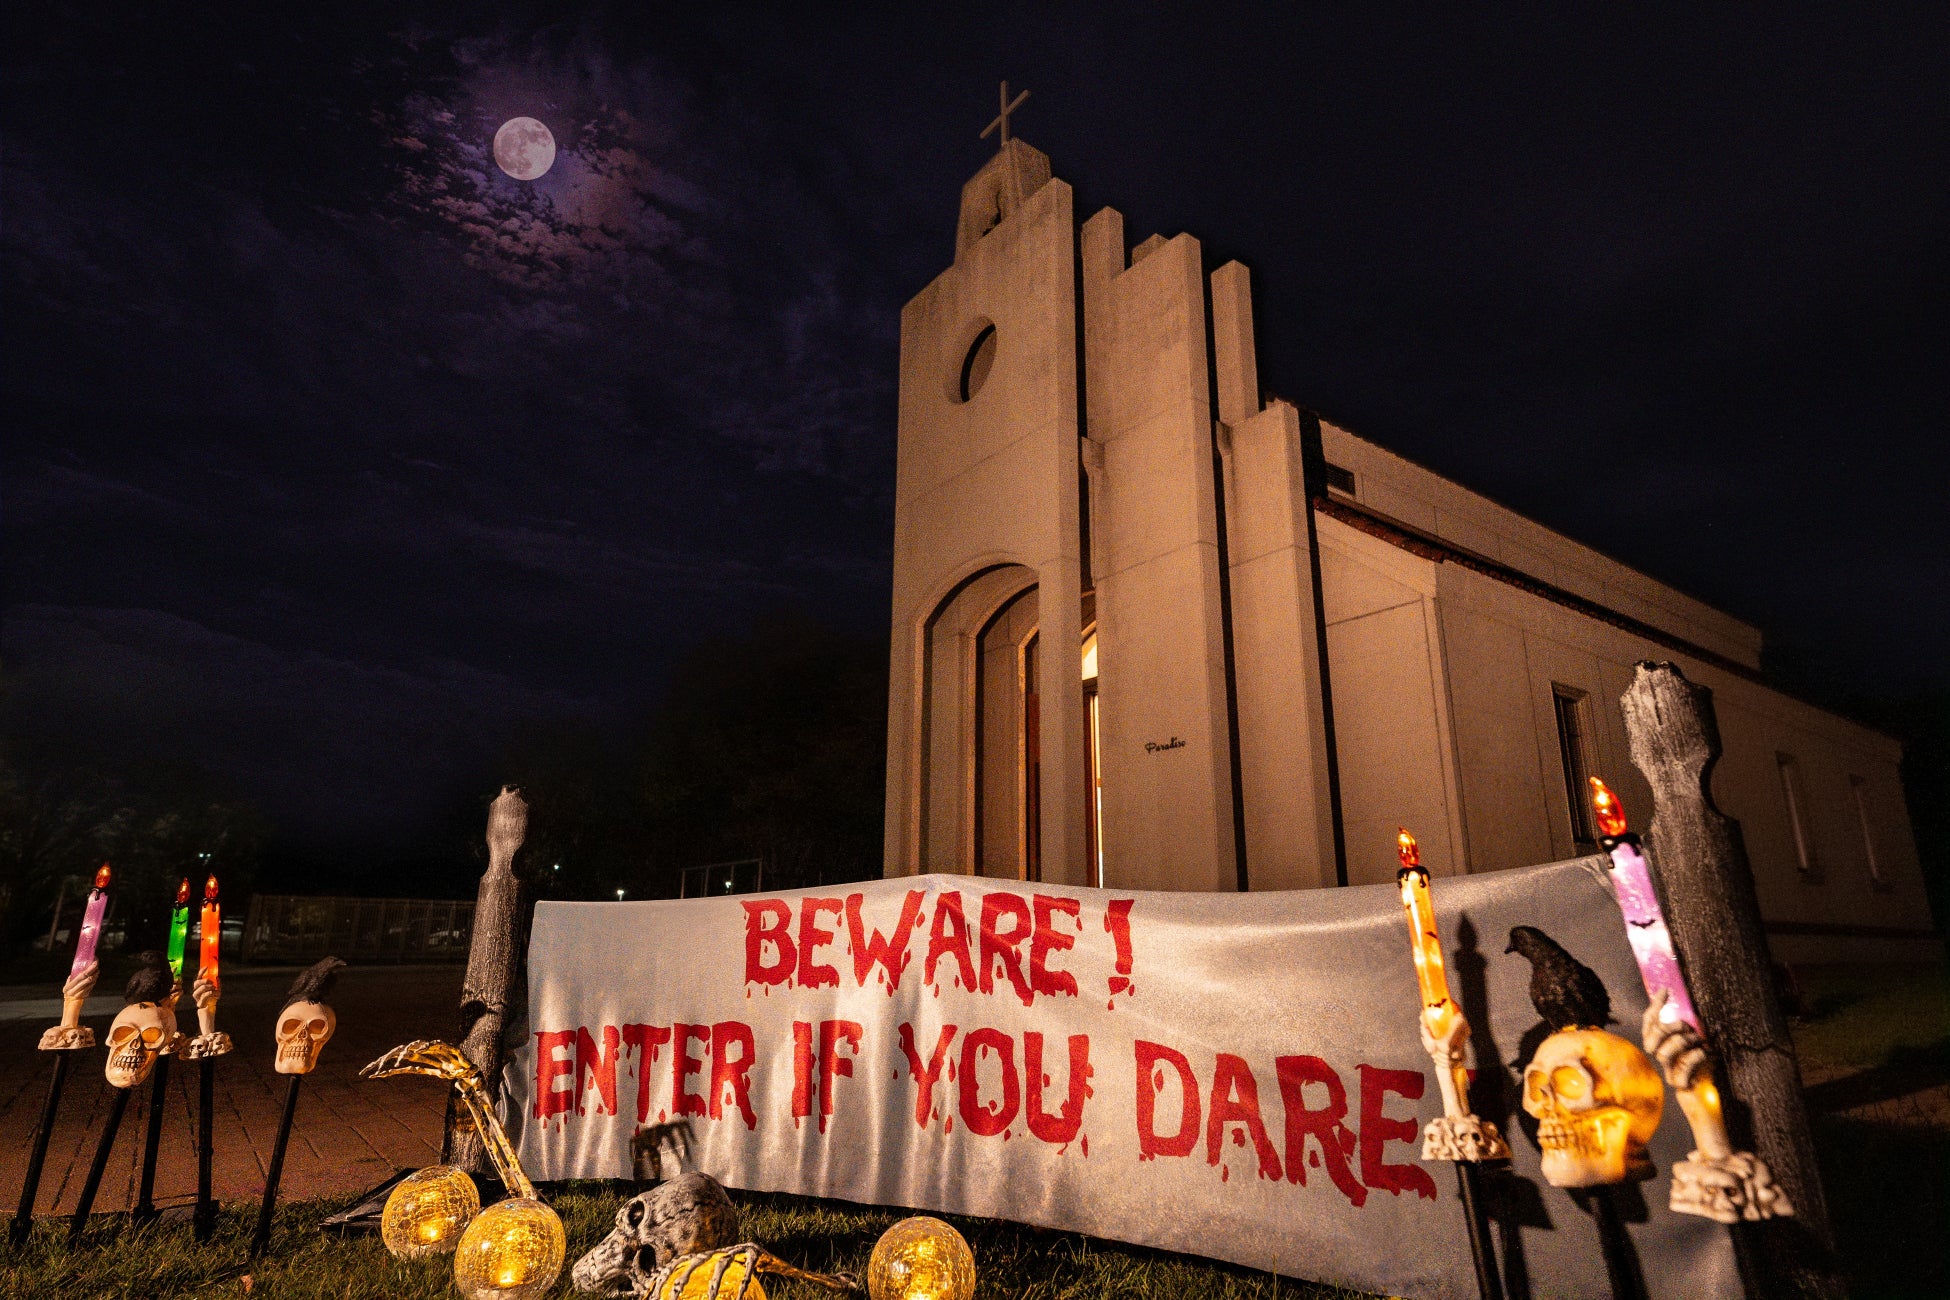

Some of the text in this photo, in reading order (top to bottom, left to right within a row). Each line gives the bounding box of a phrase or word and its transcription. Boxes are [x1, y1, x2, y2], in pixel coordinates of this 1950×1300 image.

[532, 1021, 757, 1133] ENTER
[792, 1020, 863, 1132] IF
[895, 1021, 1094, 1156] YOU
[1134, 1040, 1437, 1207] DARE
